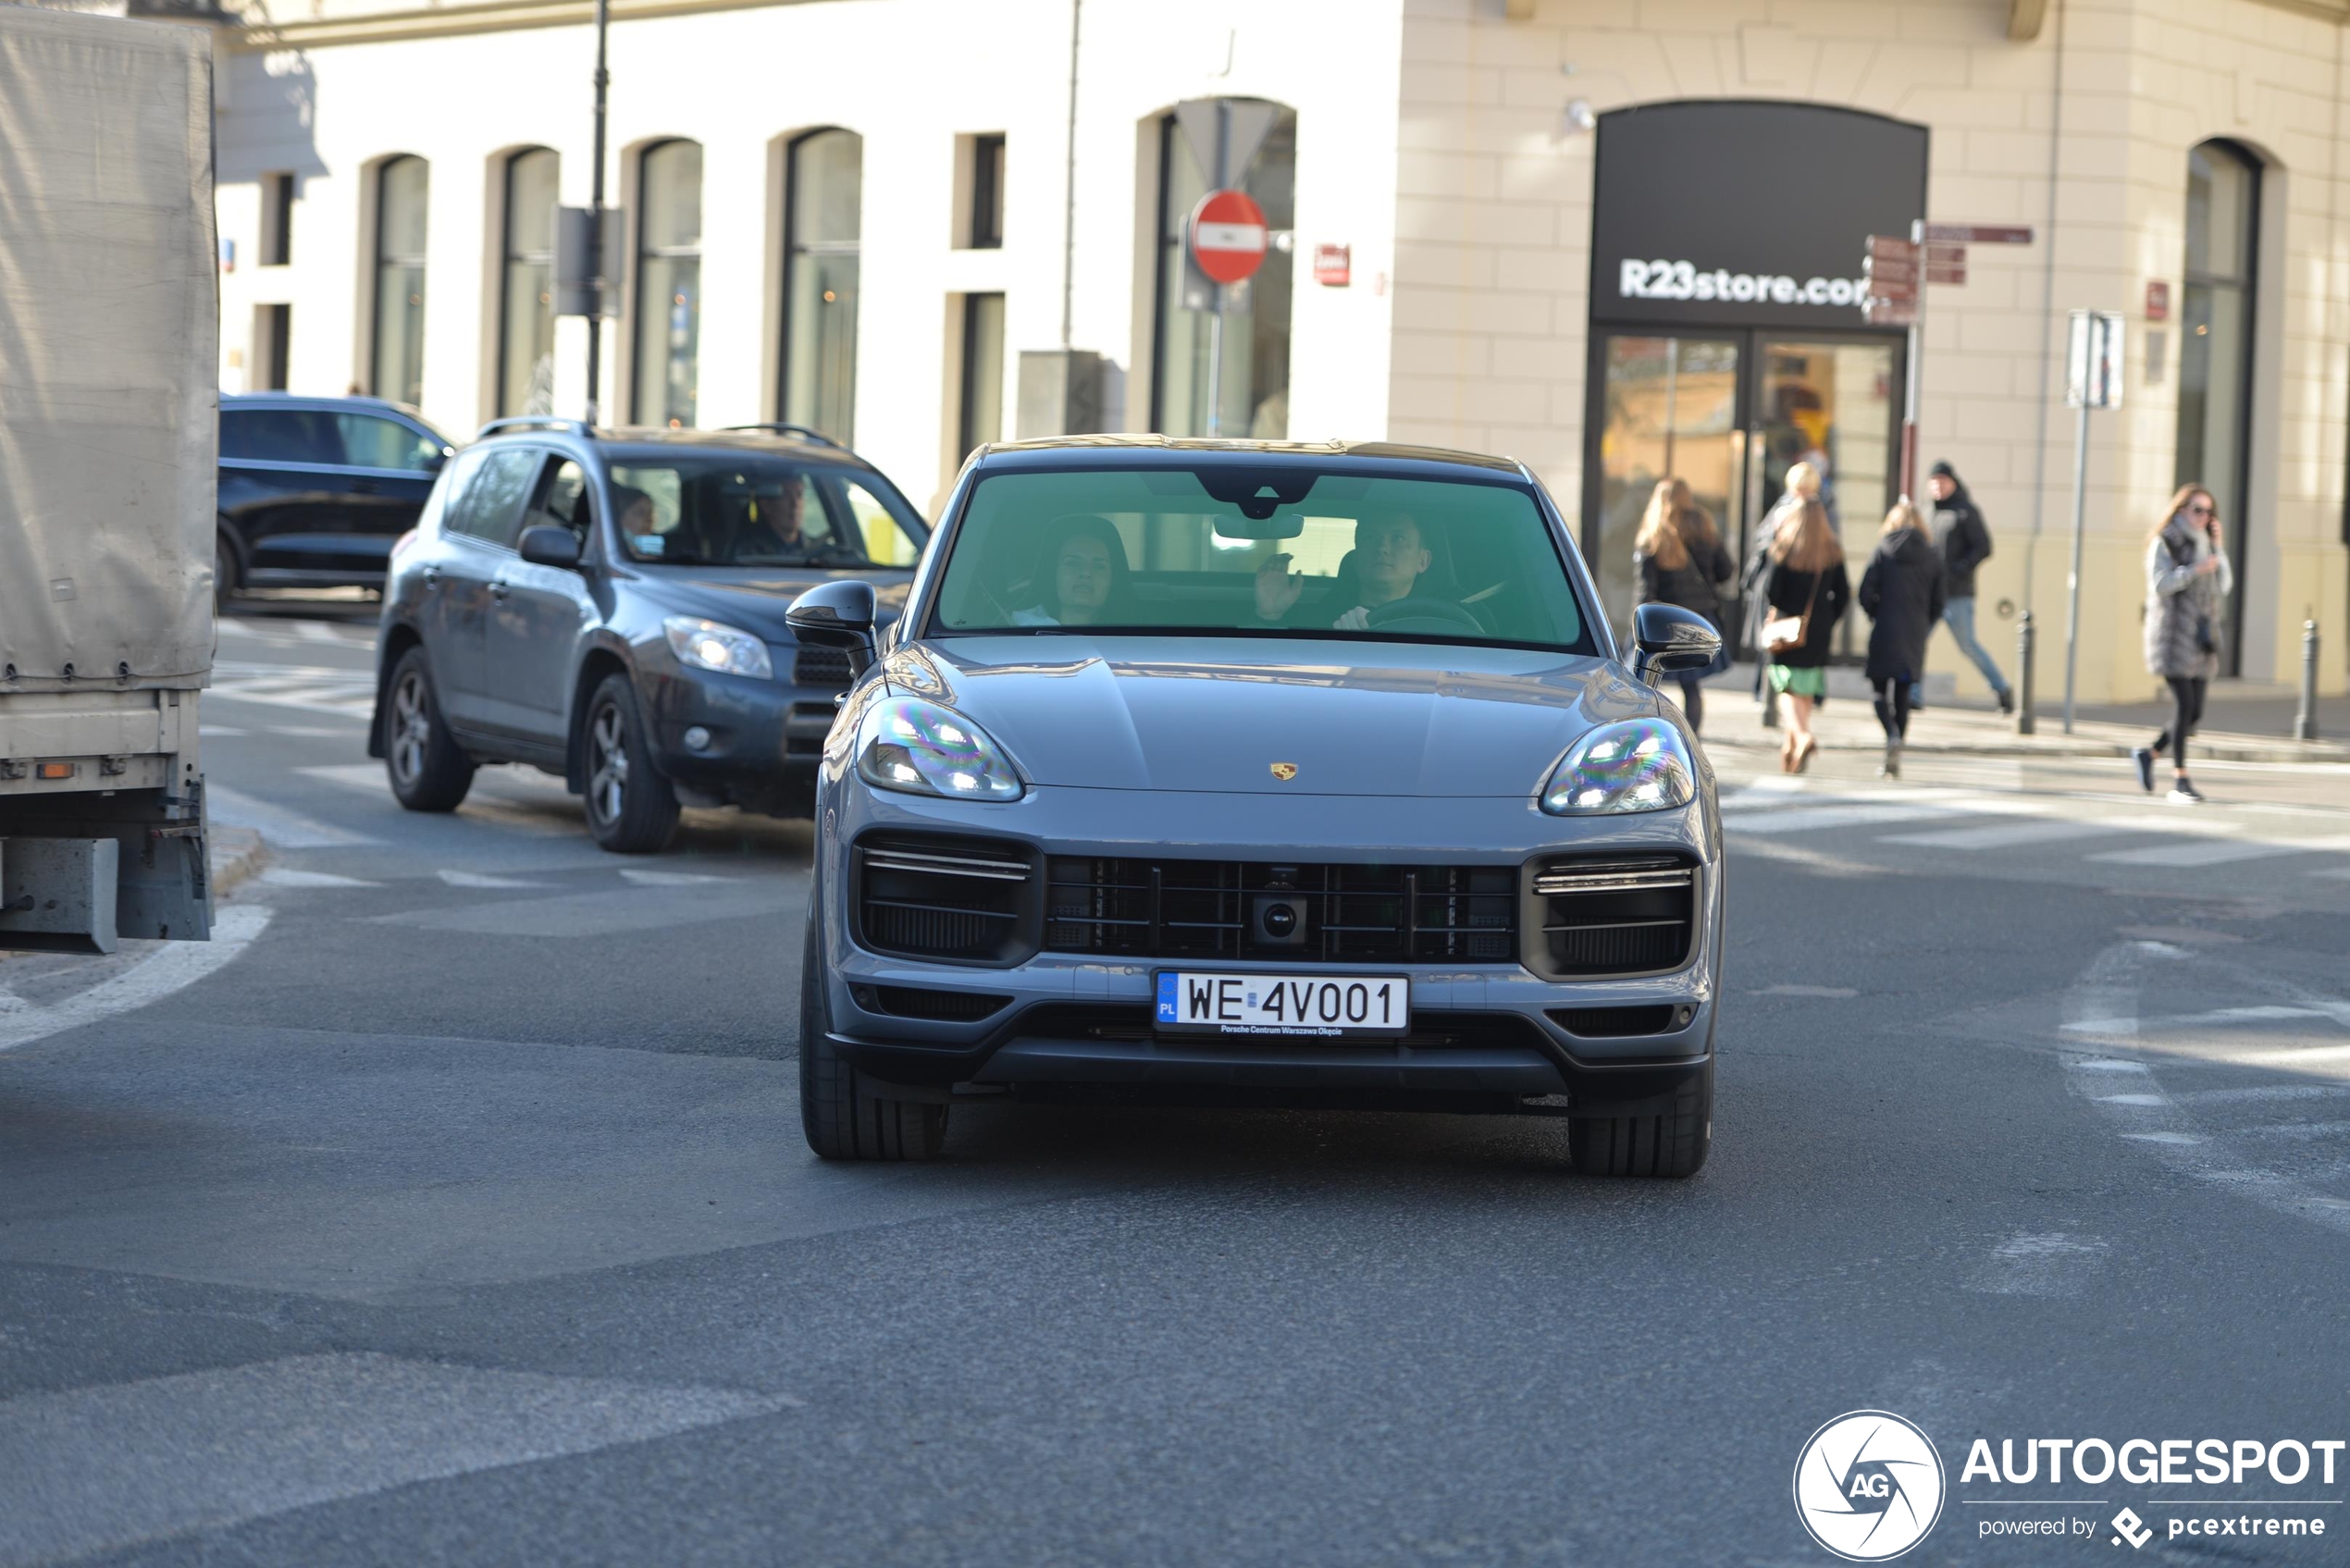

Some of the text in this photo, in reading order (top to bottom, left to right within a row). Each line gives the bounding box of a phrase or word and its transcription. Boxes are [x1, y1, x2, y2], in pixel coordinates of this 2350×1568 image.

[1188, 978, 1391, 1024] WE 4V001
[1159, 1004, 1175, 1015] PL
[1221, 1025, 1342, 1036] Porsche Centrum Warszawa Okęcie
